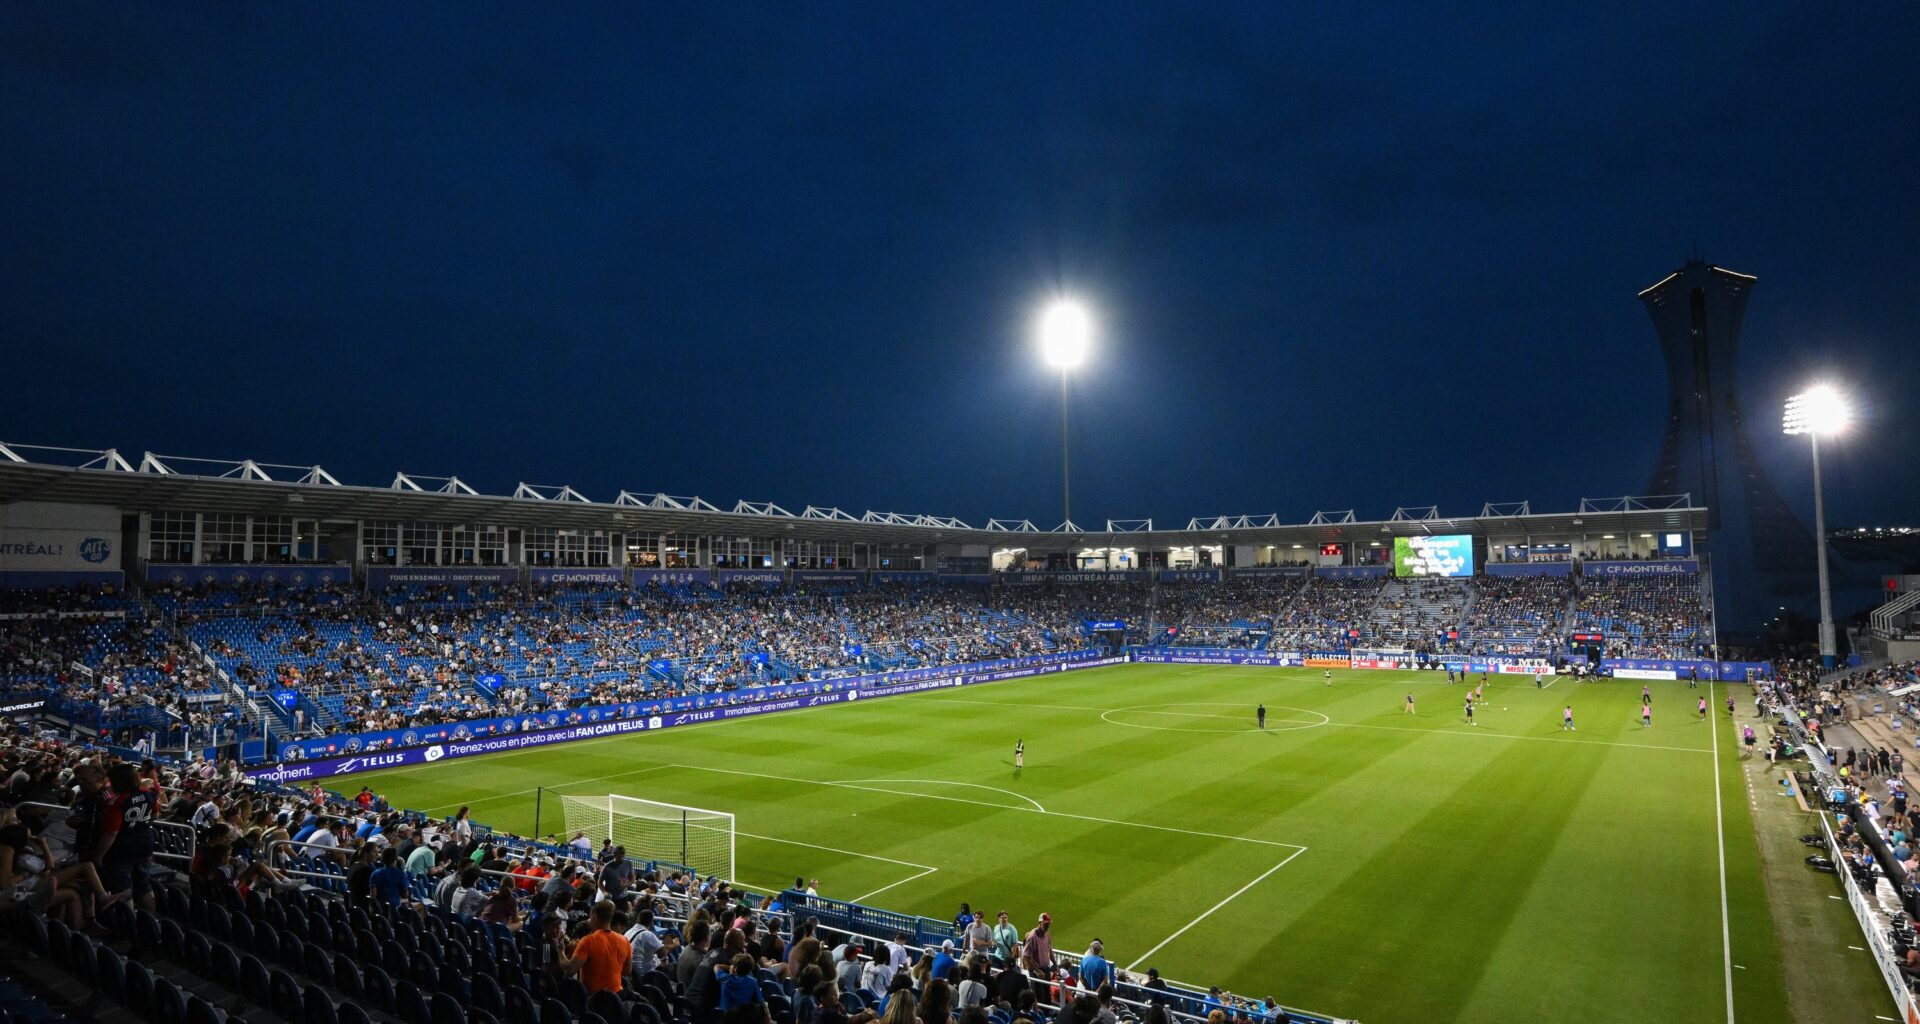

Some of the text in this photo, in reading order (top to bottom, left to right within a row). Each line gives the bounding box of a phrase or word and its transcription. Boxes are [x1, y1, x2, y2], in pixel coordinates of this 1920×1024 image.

[1623, 563, 1685, 573] MONTRÉAL
[552, 572, 618, 582] CF MONTRÉAL
[820, 694, 840, 702] TELUS
[690, 711, 715, 720] TELUS
[725, 704, 761, 716] Immortalisez
[762, 702, 776, 711] votre
[362, 754, 405, 767] TELUS
[450, 741, 507, 755] Prenez-vous
[509, 738, 520, 747] en
[521, 734, 546, 747] photo
[547, 732, 566, 742] avec
[568, 730, 575, 739] la
[576, 726, 594, 737] FAN
[596, 723, 616, 734] CAM
